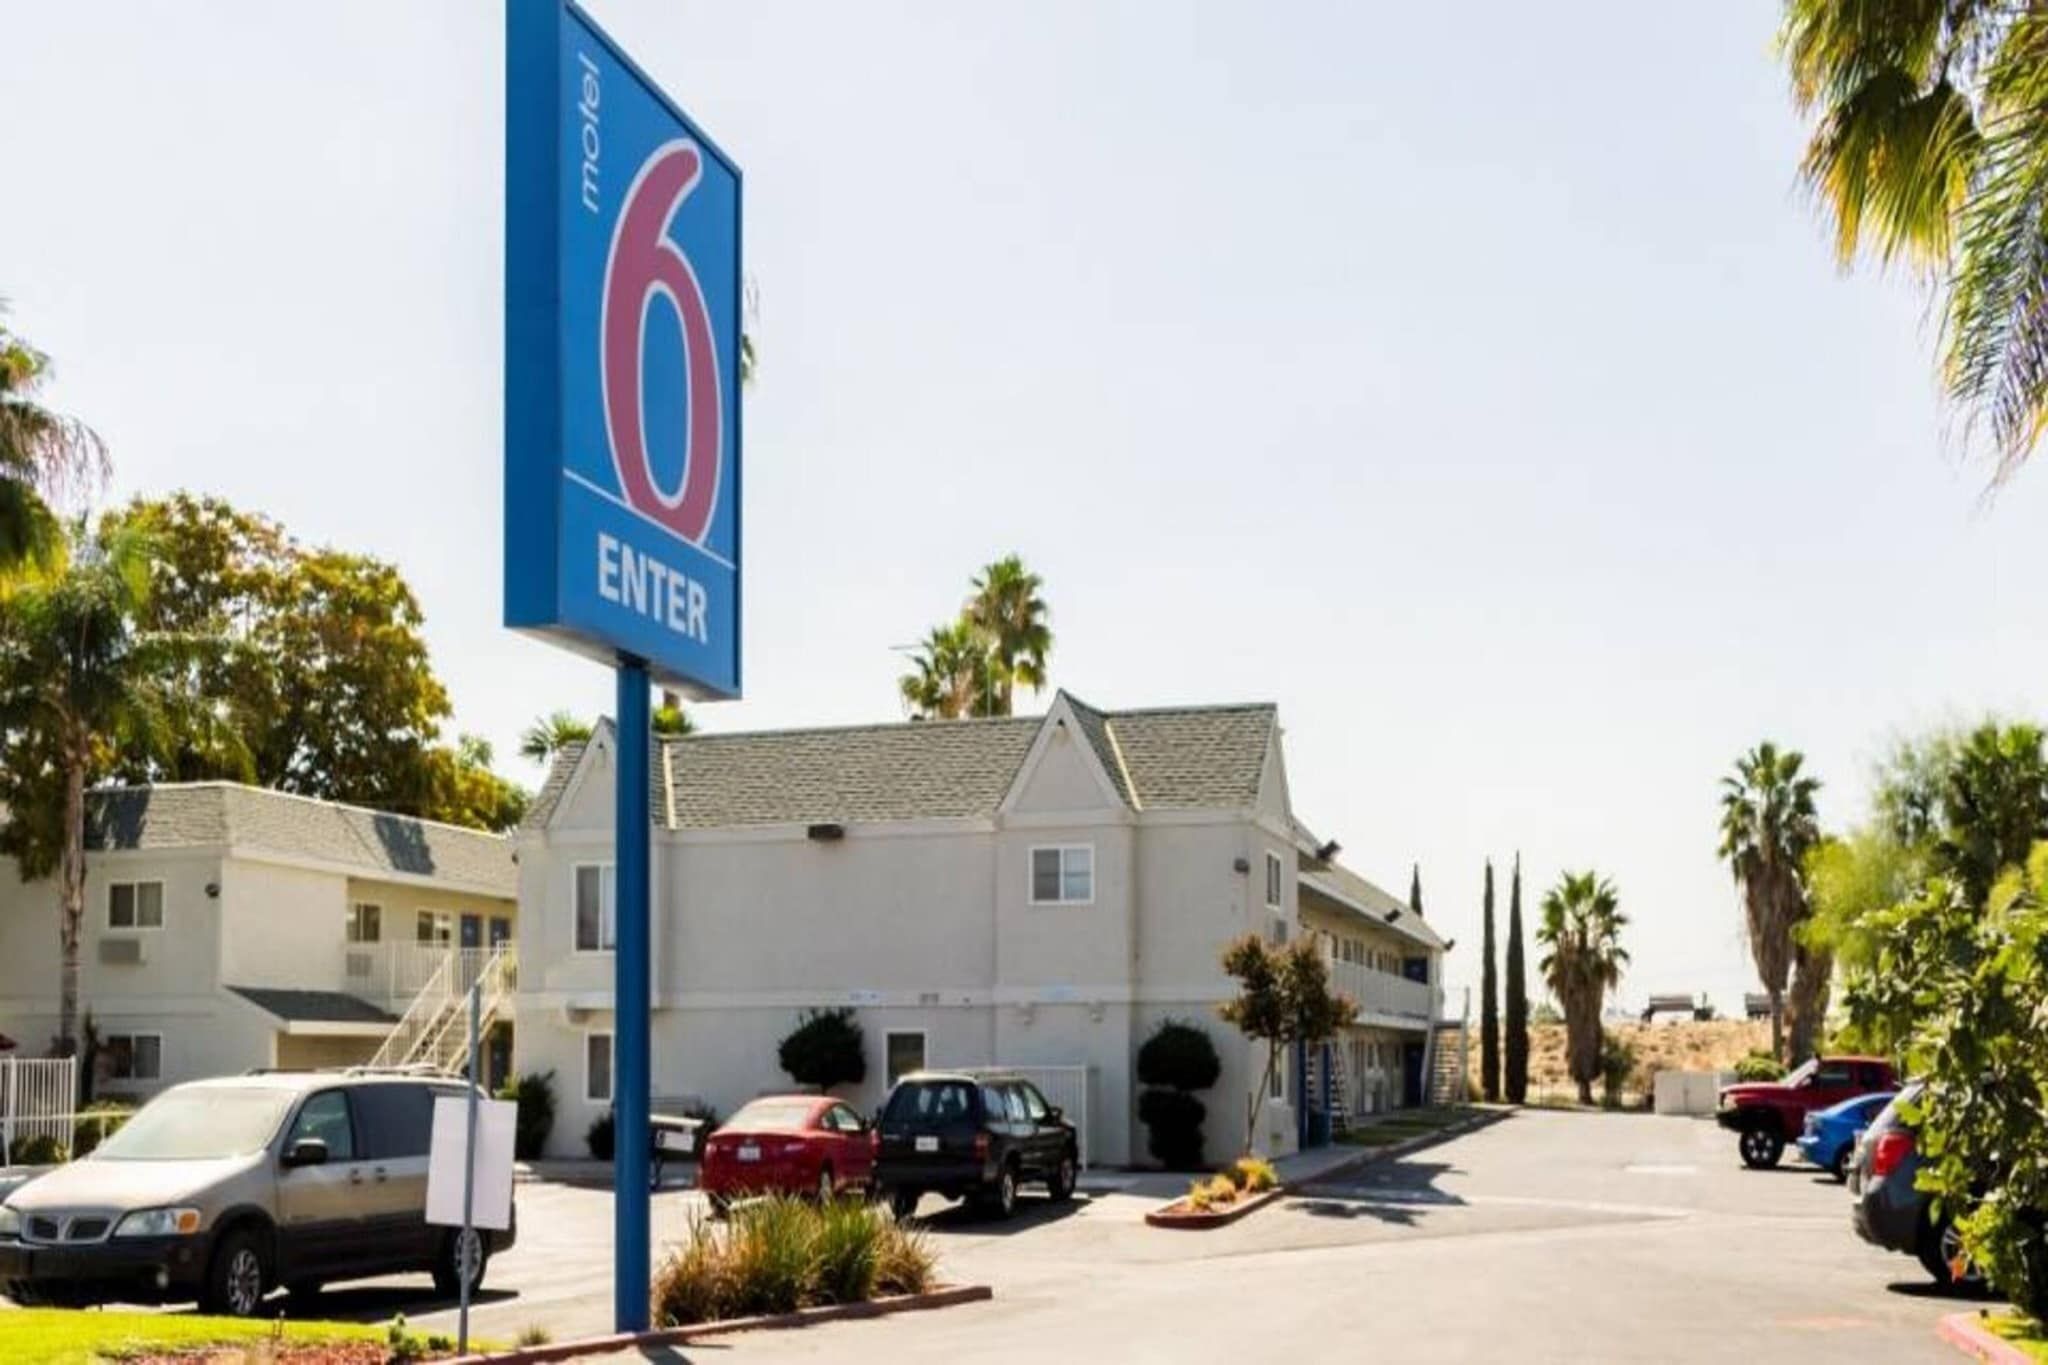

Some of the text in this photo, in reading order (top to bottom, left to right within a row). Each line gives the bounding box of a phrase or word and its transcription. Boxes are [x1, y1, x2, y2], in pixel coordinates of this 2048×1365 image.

[577, 51, 600, 214] motel
[600, 137, 723, 546] 6
[597, 530, 708, 645] ENTER
